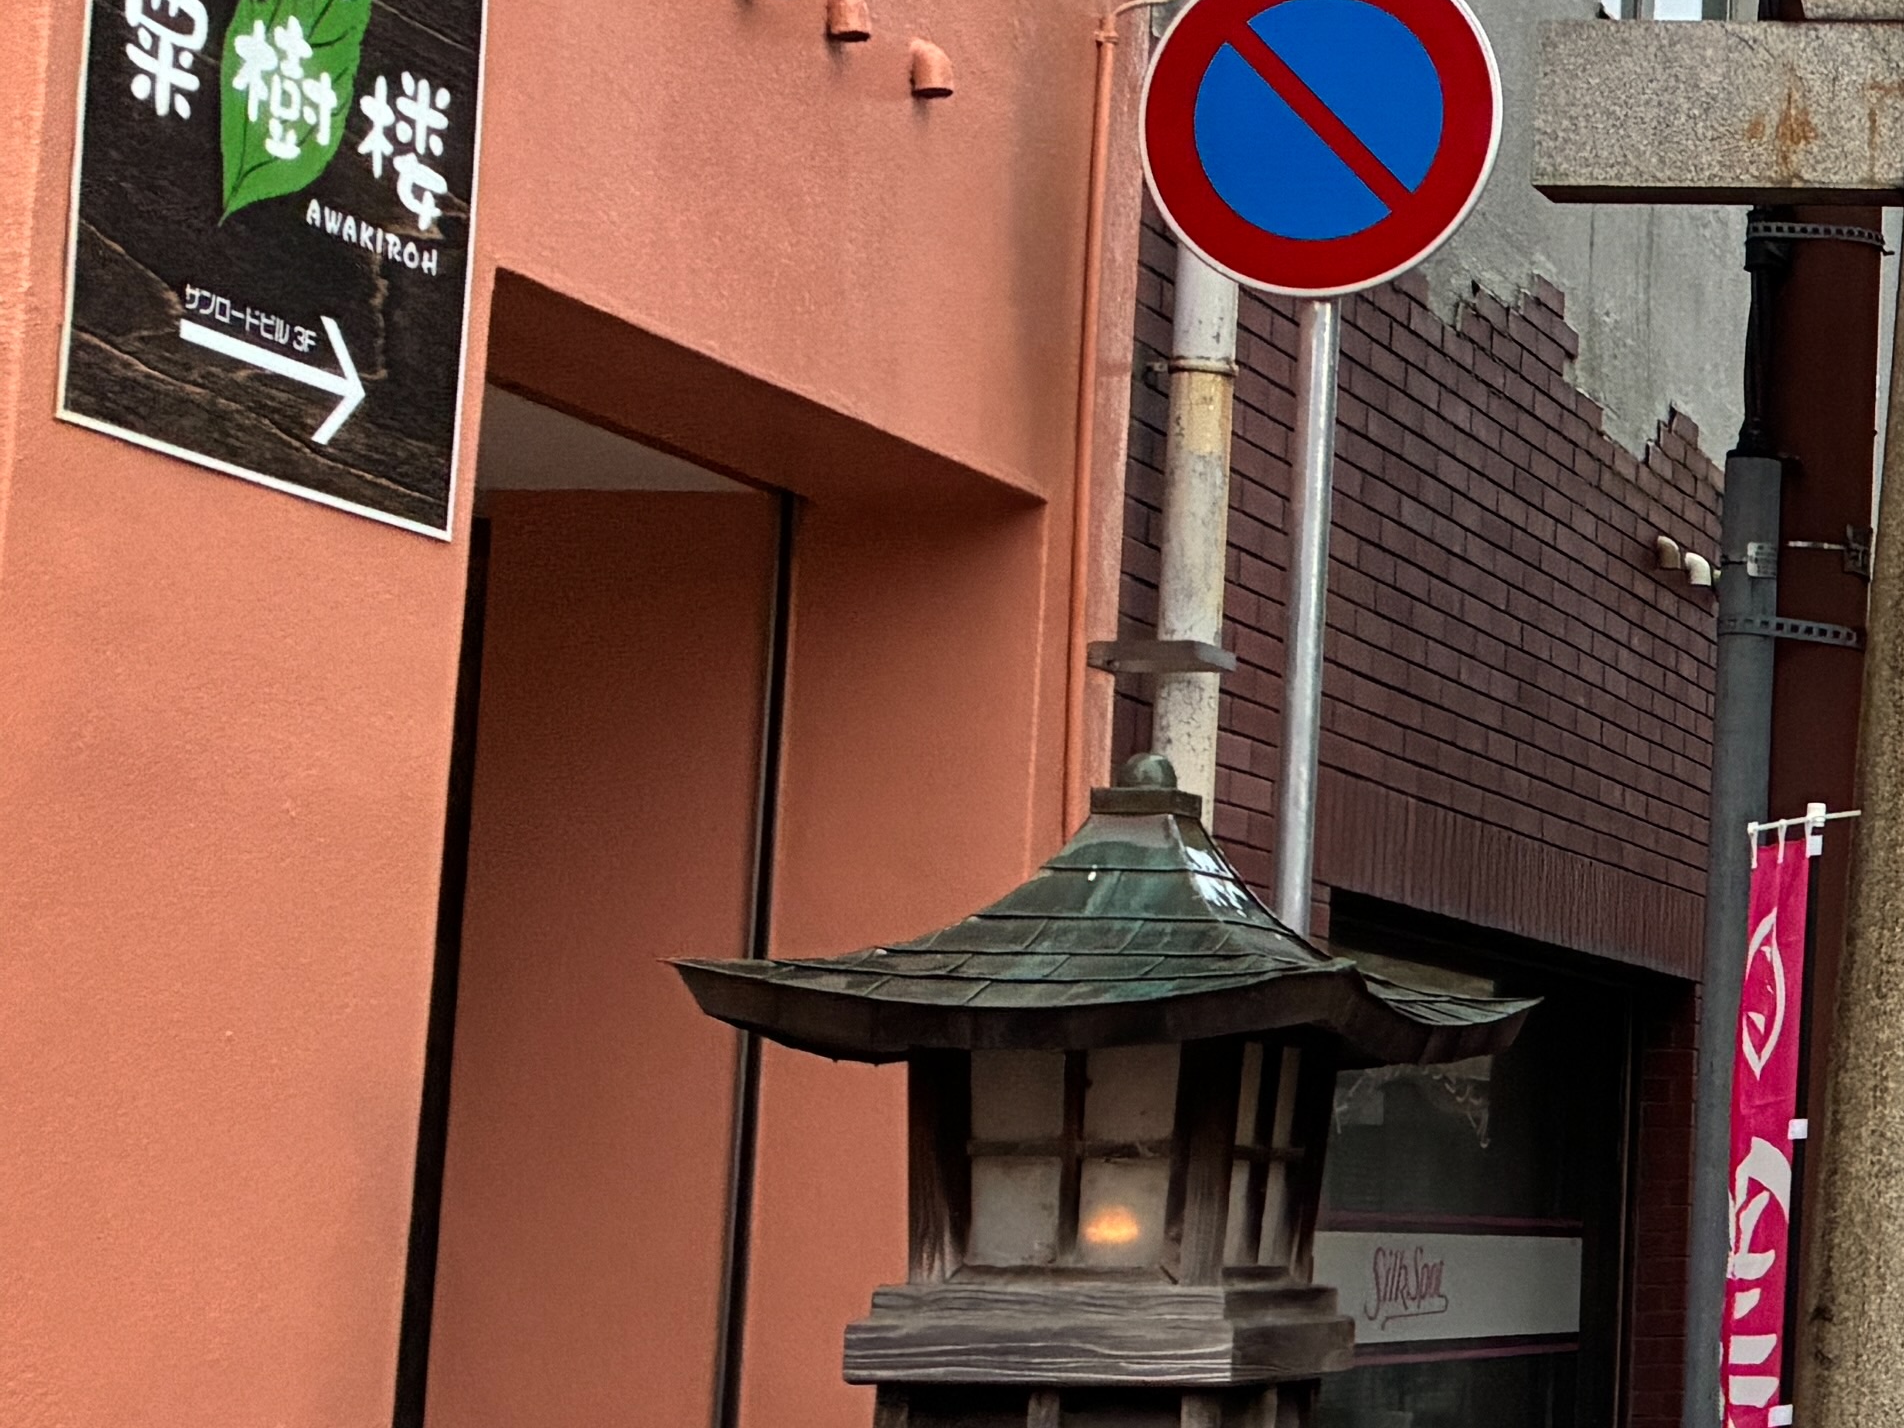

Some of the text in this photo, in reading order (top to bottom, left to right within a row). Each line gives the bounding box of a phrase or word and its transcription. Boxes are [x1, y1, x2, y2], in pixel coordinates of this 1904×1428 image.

[306, 198, 438, 276] AWAKIROH
[184, 283, 318, 353] サンロードビル 3F
